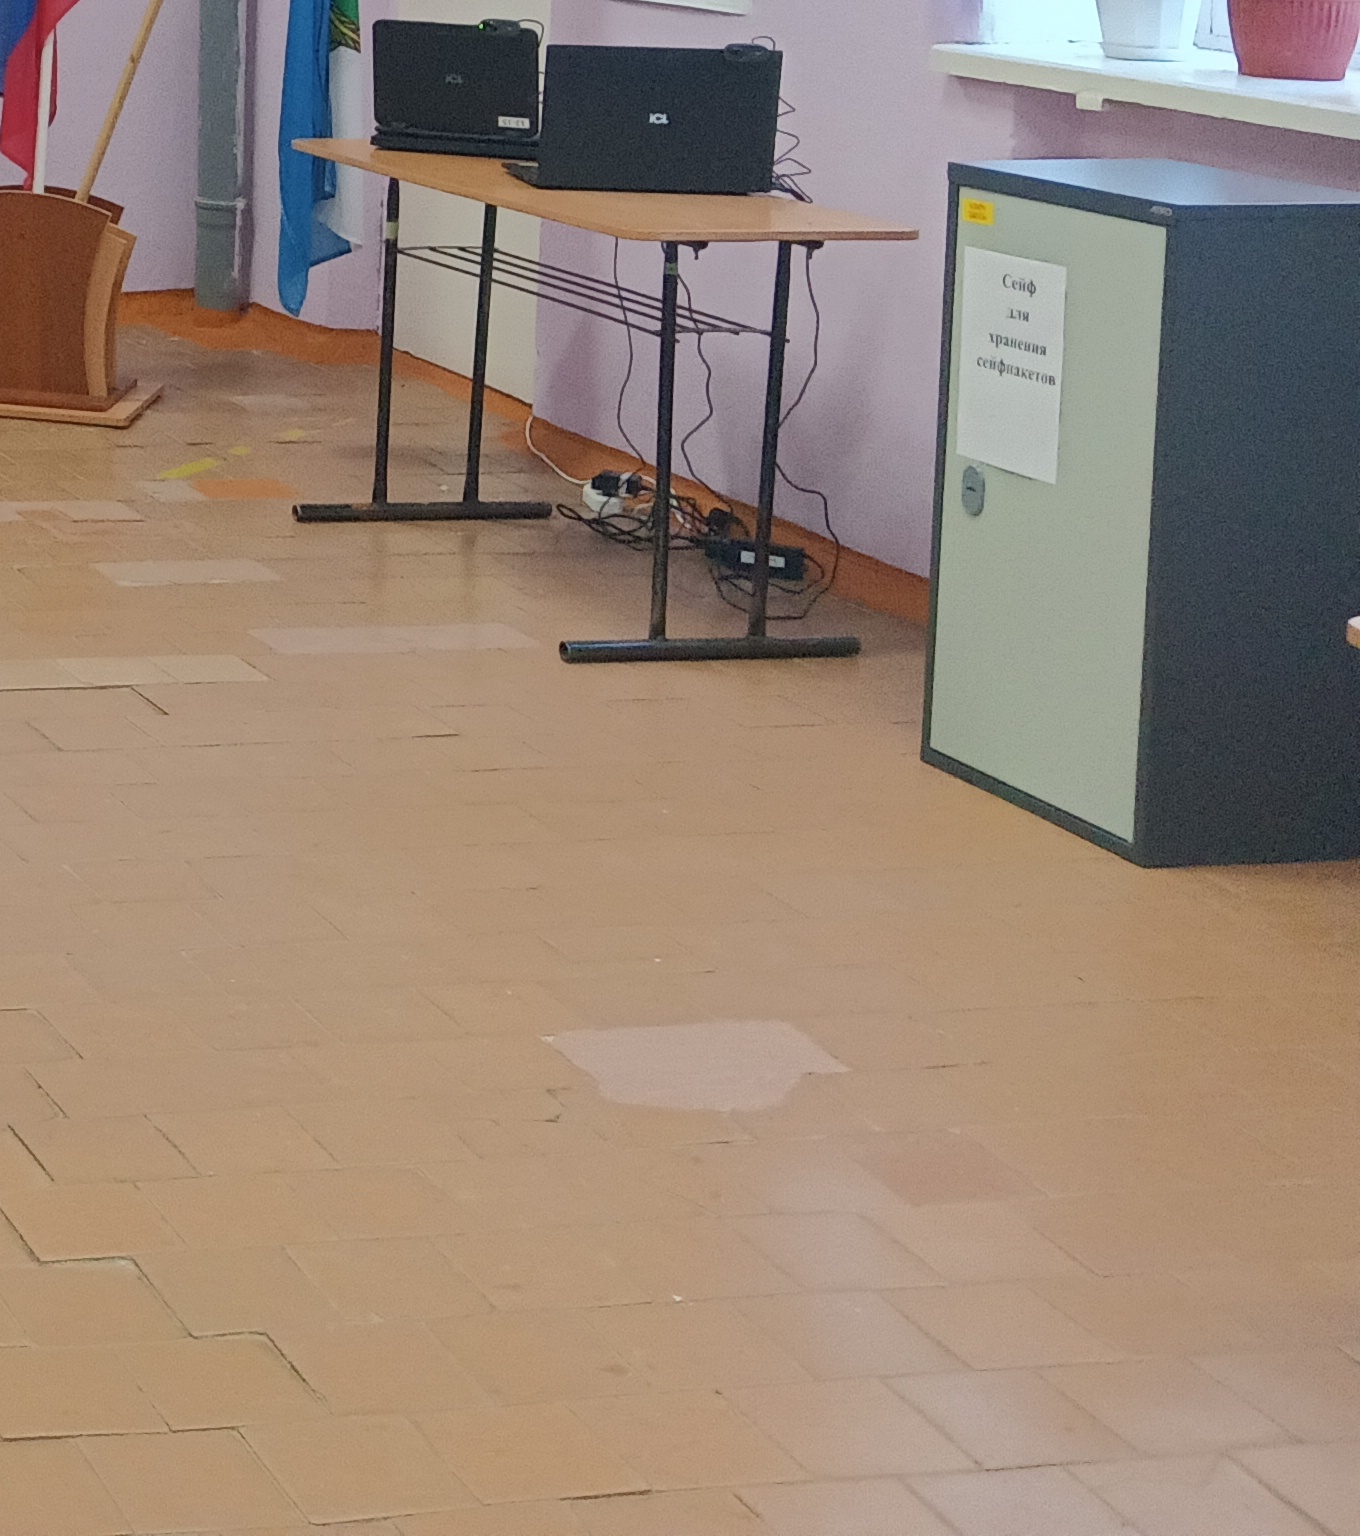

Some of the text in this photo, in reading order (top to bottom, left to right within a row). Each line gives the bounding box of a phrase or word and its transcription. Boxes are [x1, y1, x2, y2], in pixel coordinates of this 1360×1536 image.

[648, 112, 670, 125] ICL
[1002, 273, 1037, 297] Сейф
[988, 332, 1047, 356] хранения
[976, 356, 1056, 386] сейфпакетов
